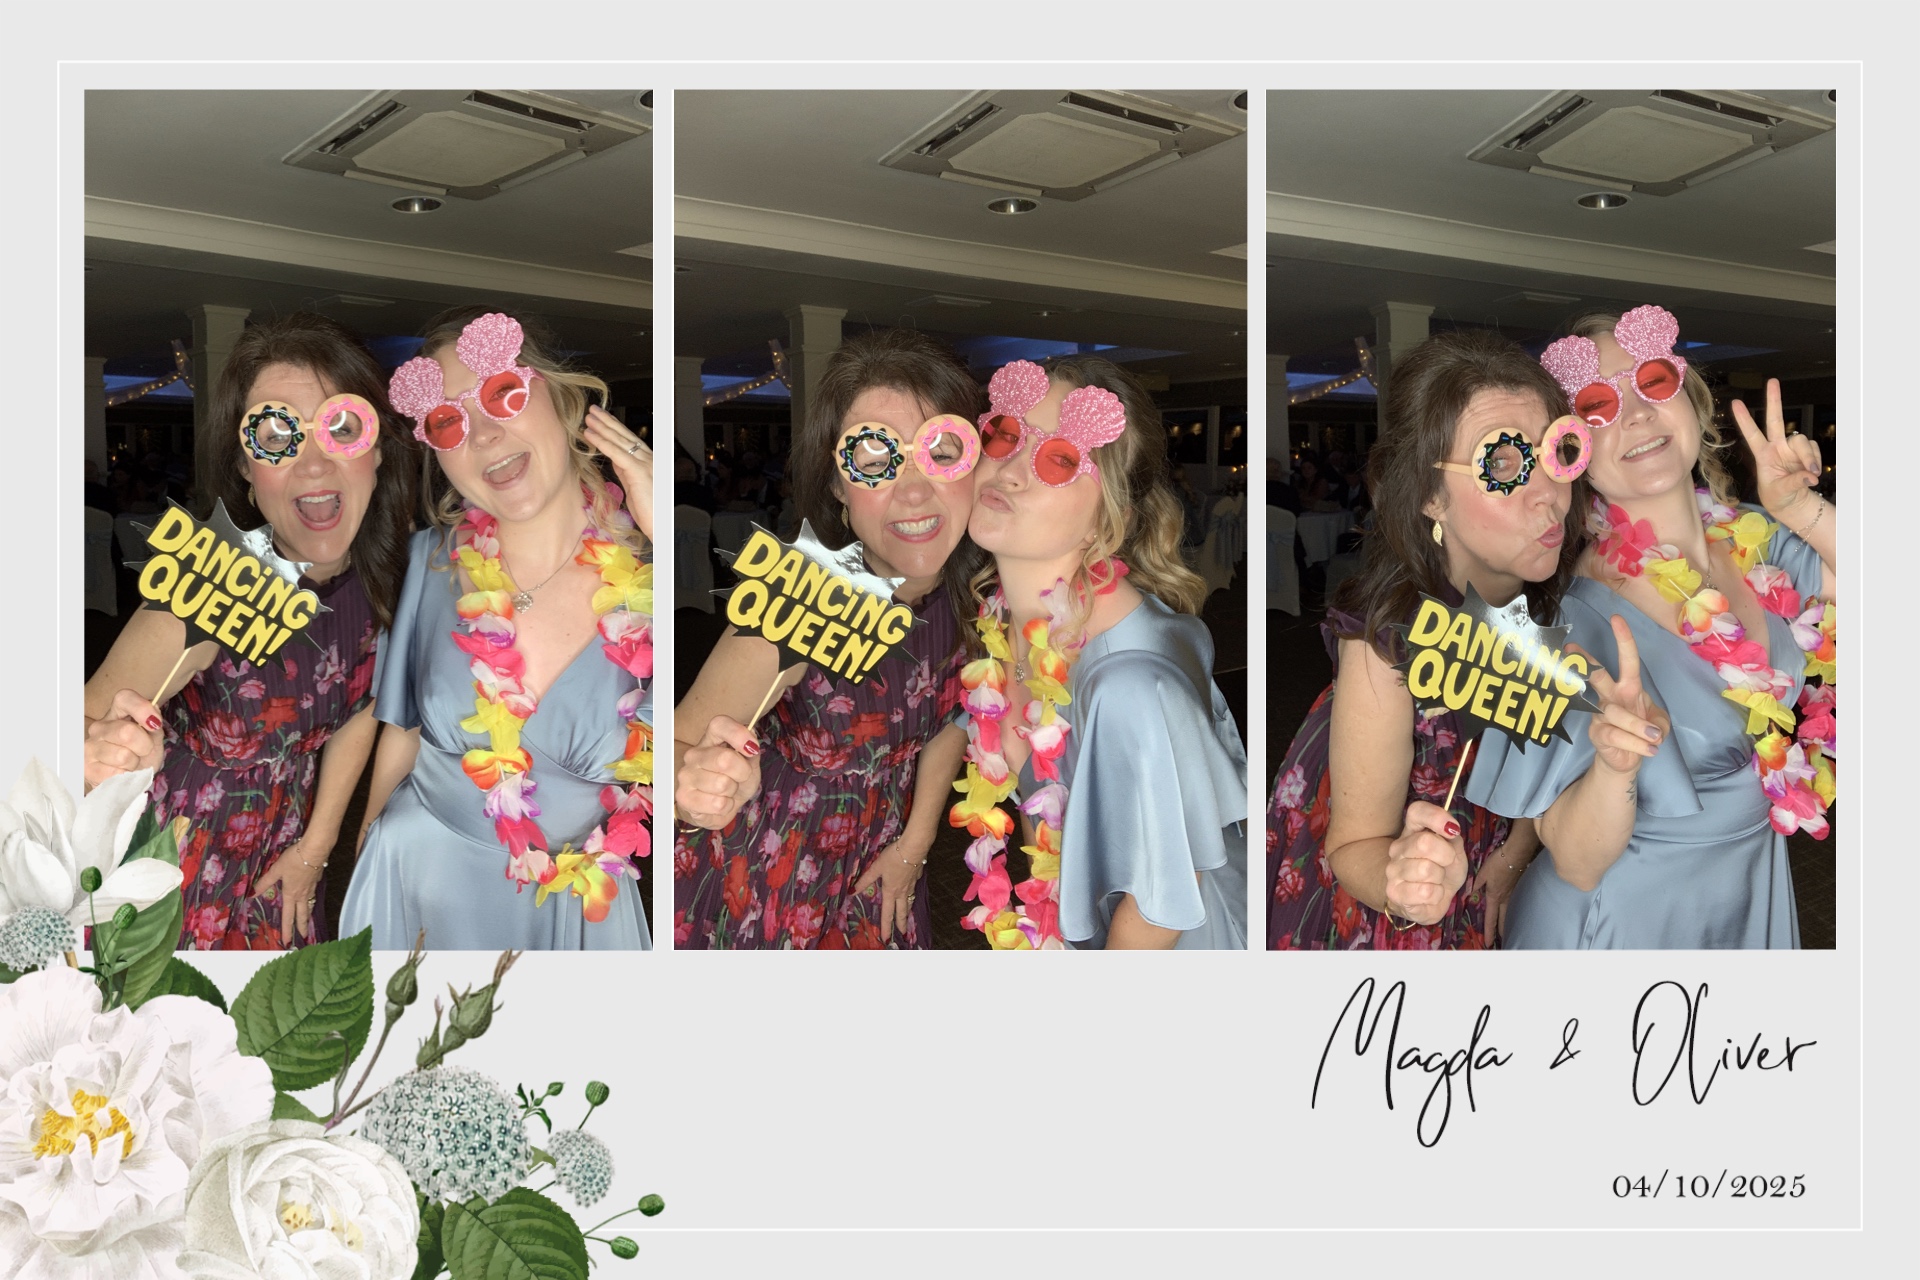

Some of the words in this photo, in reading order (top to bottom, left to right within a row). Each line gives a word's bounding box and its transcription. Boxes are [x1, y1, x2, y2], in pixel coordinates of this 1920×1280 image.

[138, 554, 293, 667] QUEEN!
[727, 579, 889, 683] QUEEN!
[1407, 649, 1569, 743] QUEEN!
